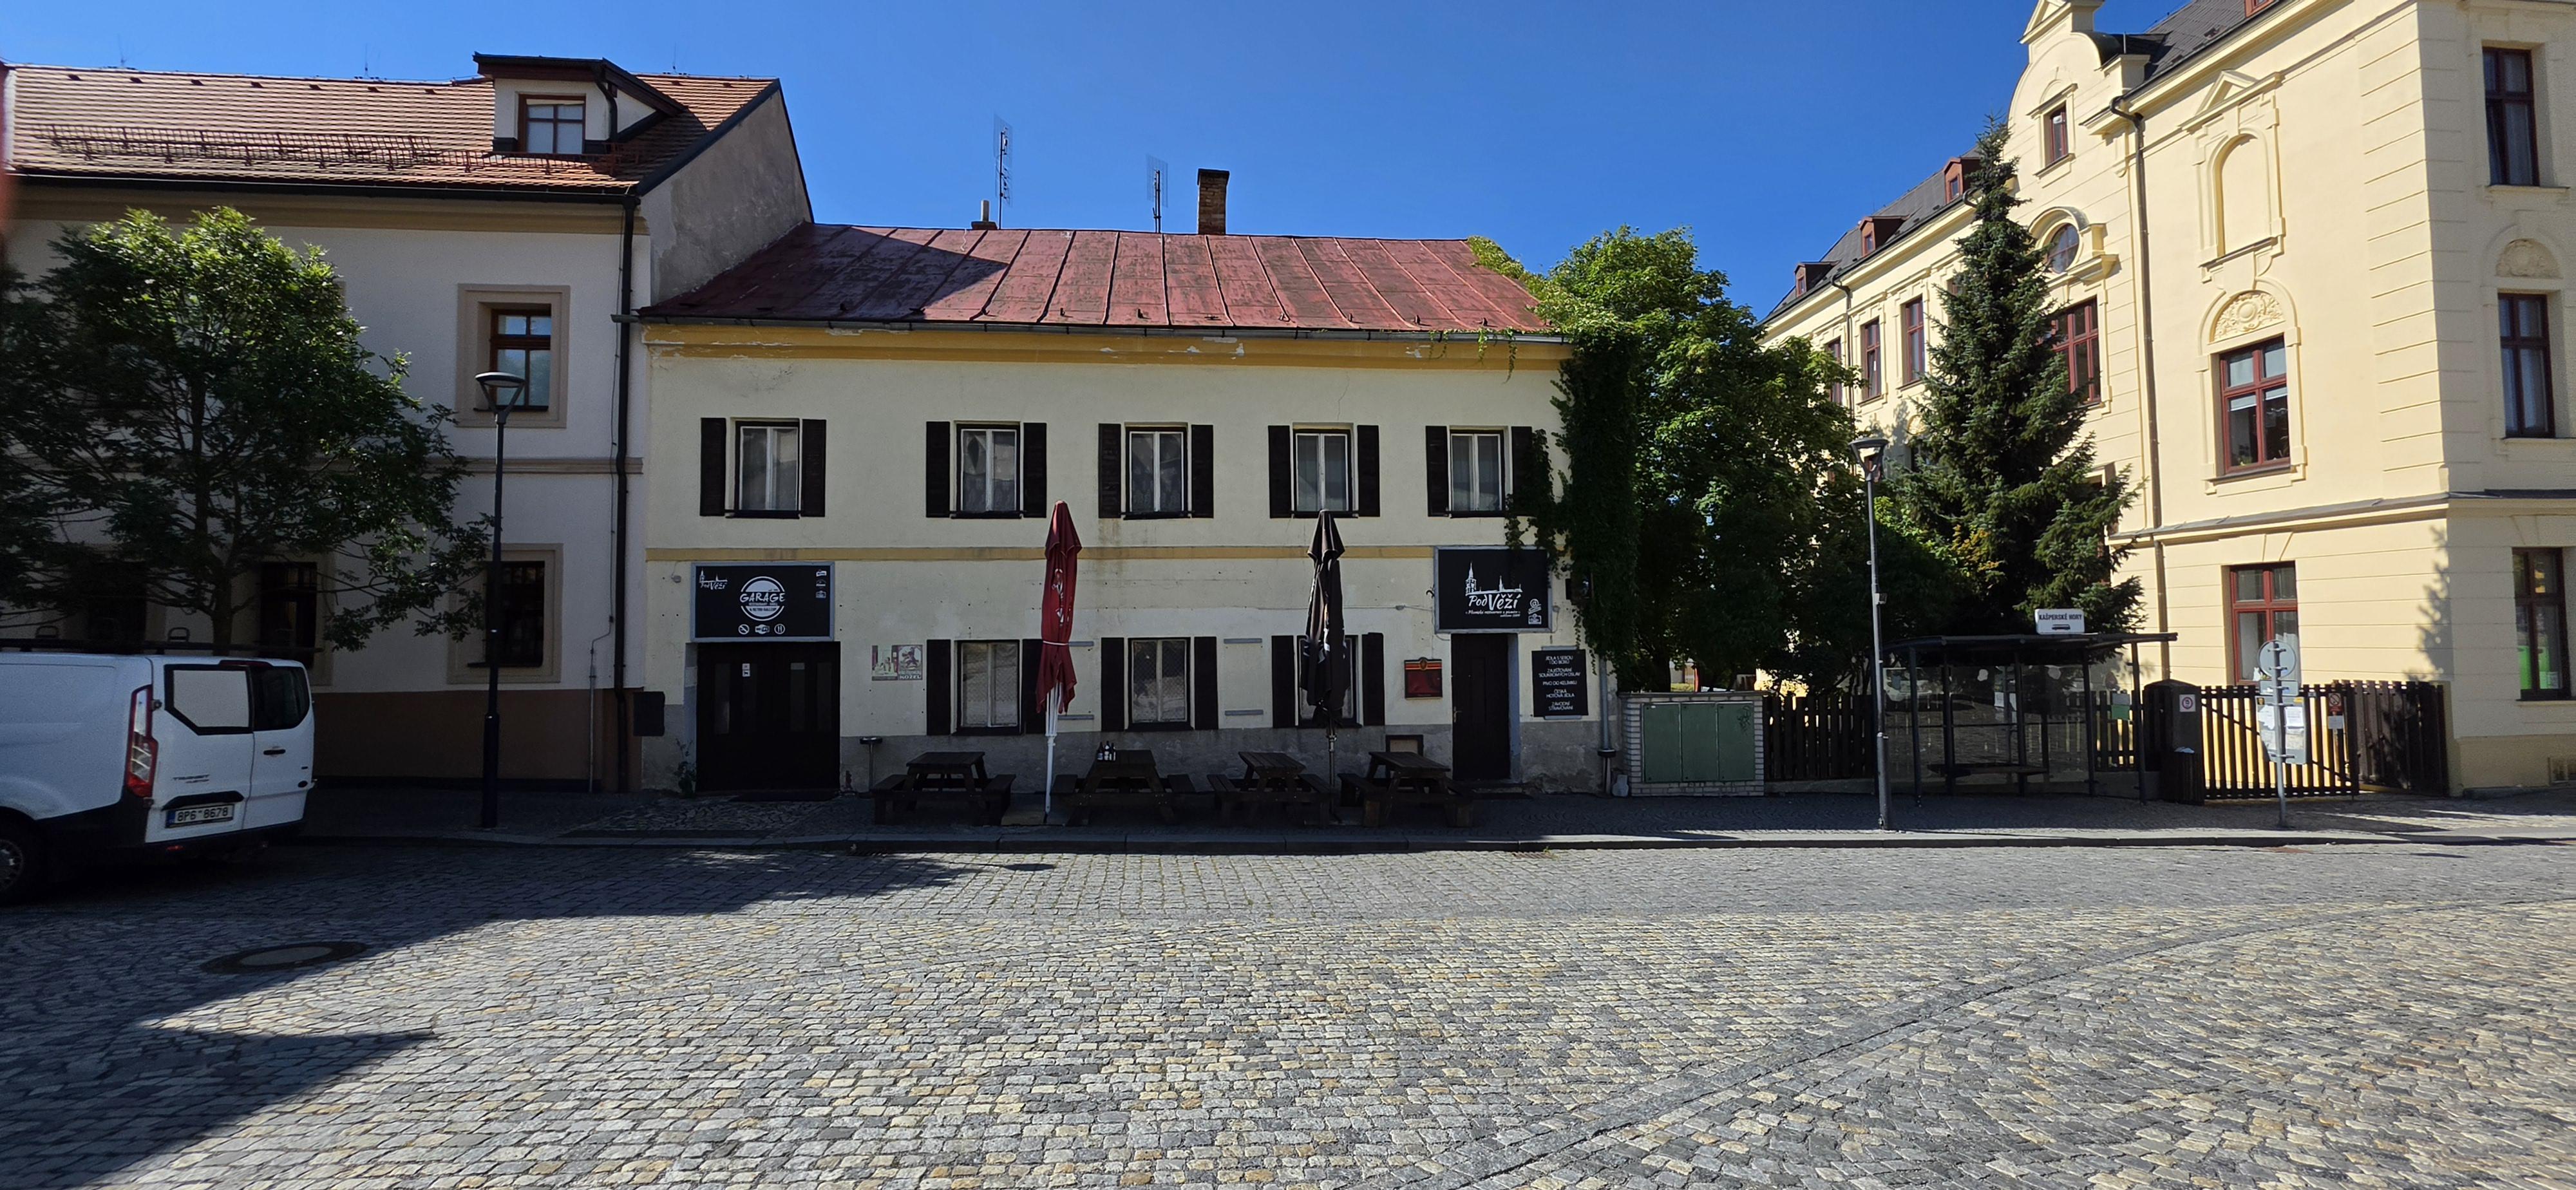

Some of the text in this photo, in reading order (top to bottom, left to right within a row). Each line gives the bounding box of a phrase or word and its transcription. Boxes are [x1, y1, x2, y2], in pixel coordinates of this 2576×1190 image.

[740, 592, 785, 603] GARAGE
[1469, 594, 1488, 607] Pod
[1488, 593, 1521, 610] Věží
[177, 807, 229, 822] 8P6 8678
